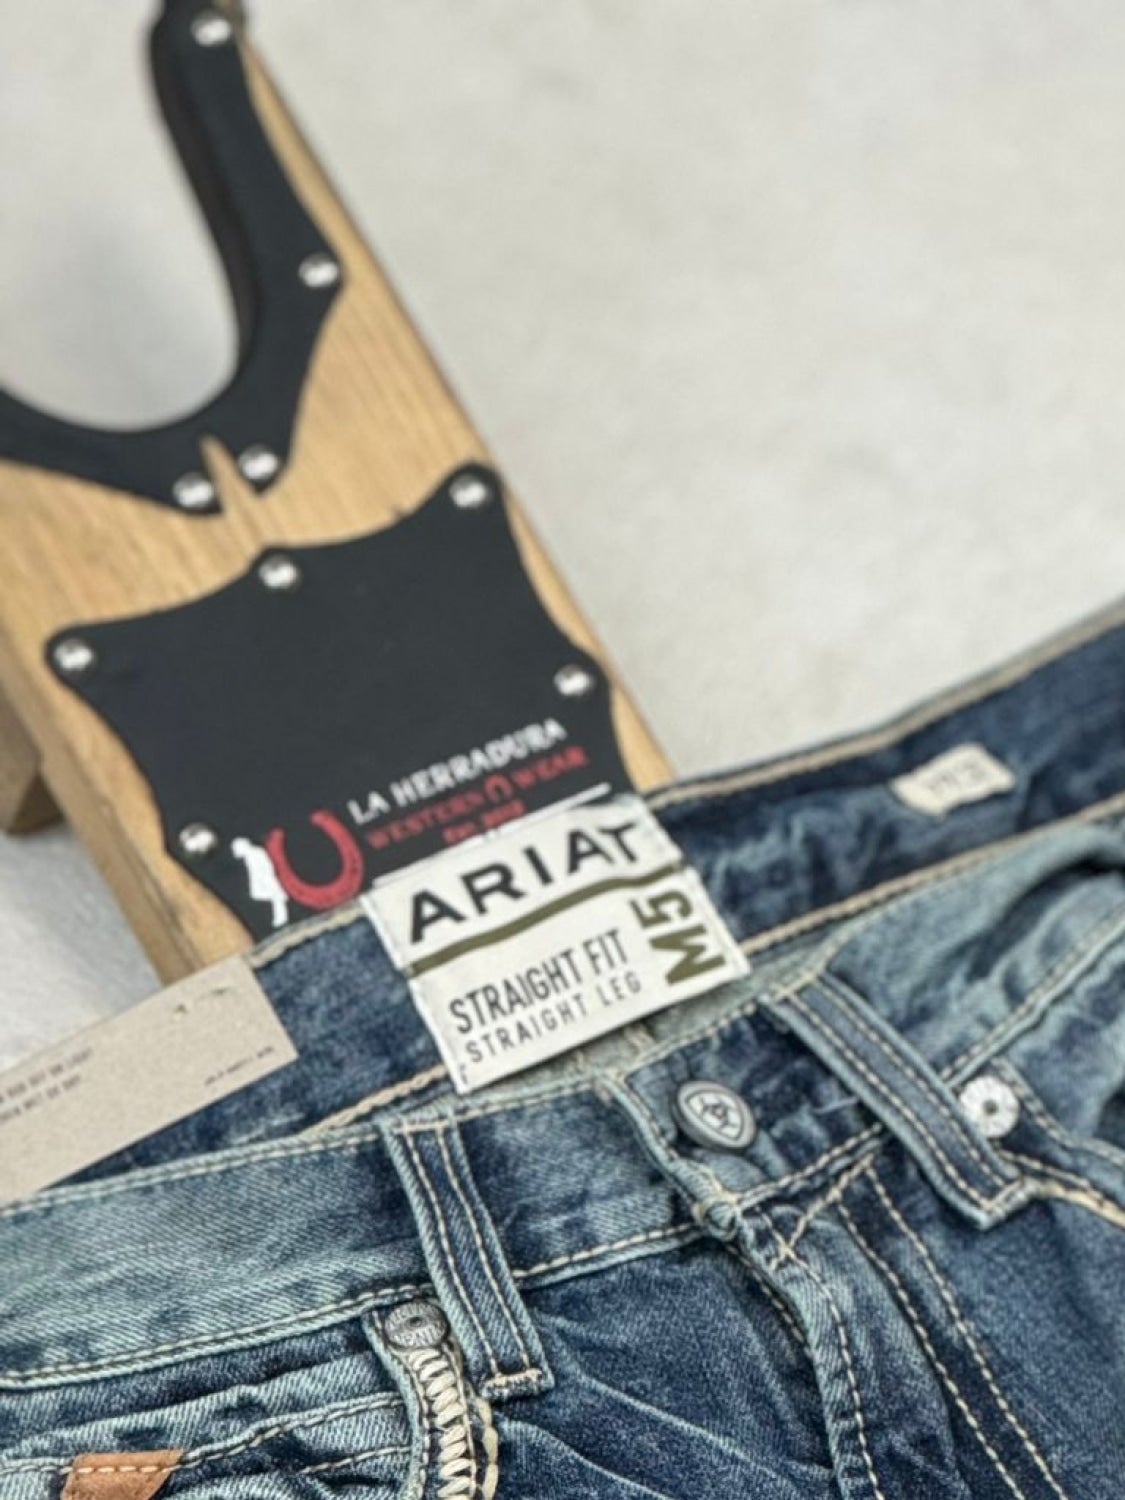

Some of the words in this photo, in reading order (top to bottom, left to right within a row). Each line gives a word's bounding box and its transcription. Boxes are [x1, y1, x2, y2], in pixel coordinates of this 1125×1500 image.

[347, 791, 391, 825] LA
[390, 718, 567, 808] HERRADURA
[410, 822, 640, 944] ARIAT
[449, 949, 582, 1034] STRAIGHT
[583, 929, 629, 976] FIT
[630, 891, 727, 987] M5
[466, 994, 588, 1064] STRAIGHT
[601, 971, 642, 1006] LEG
